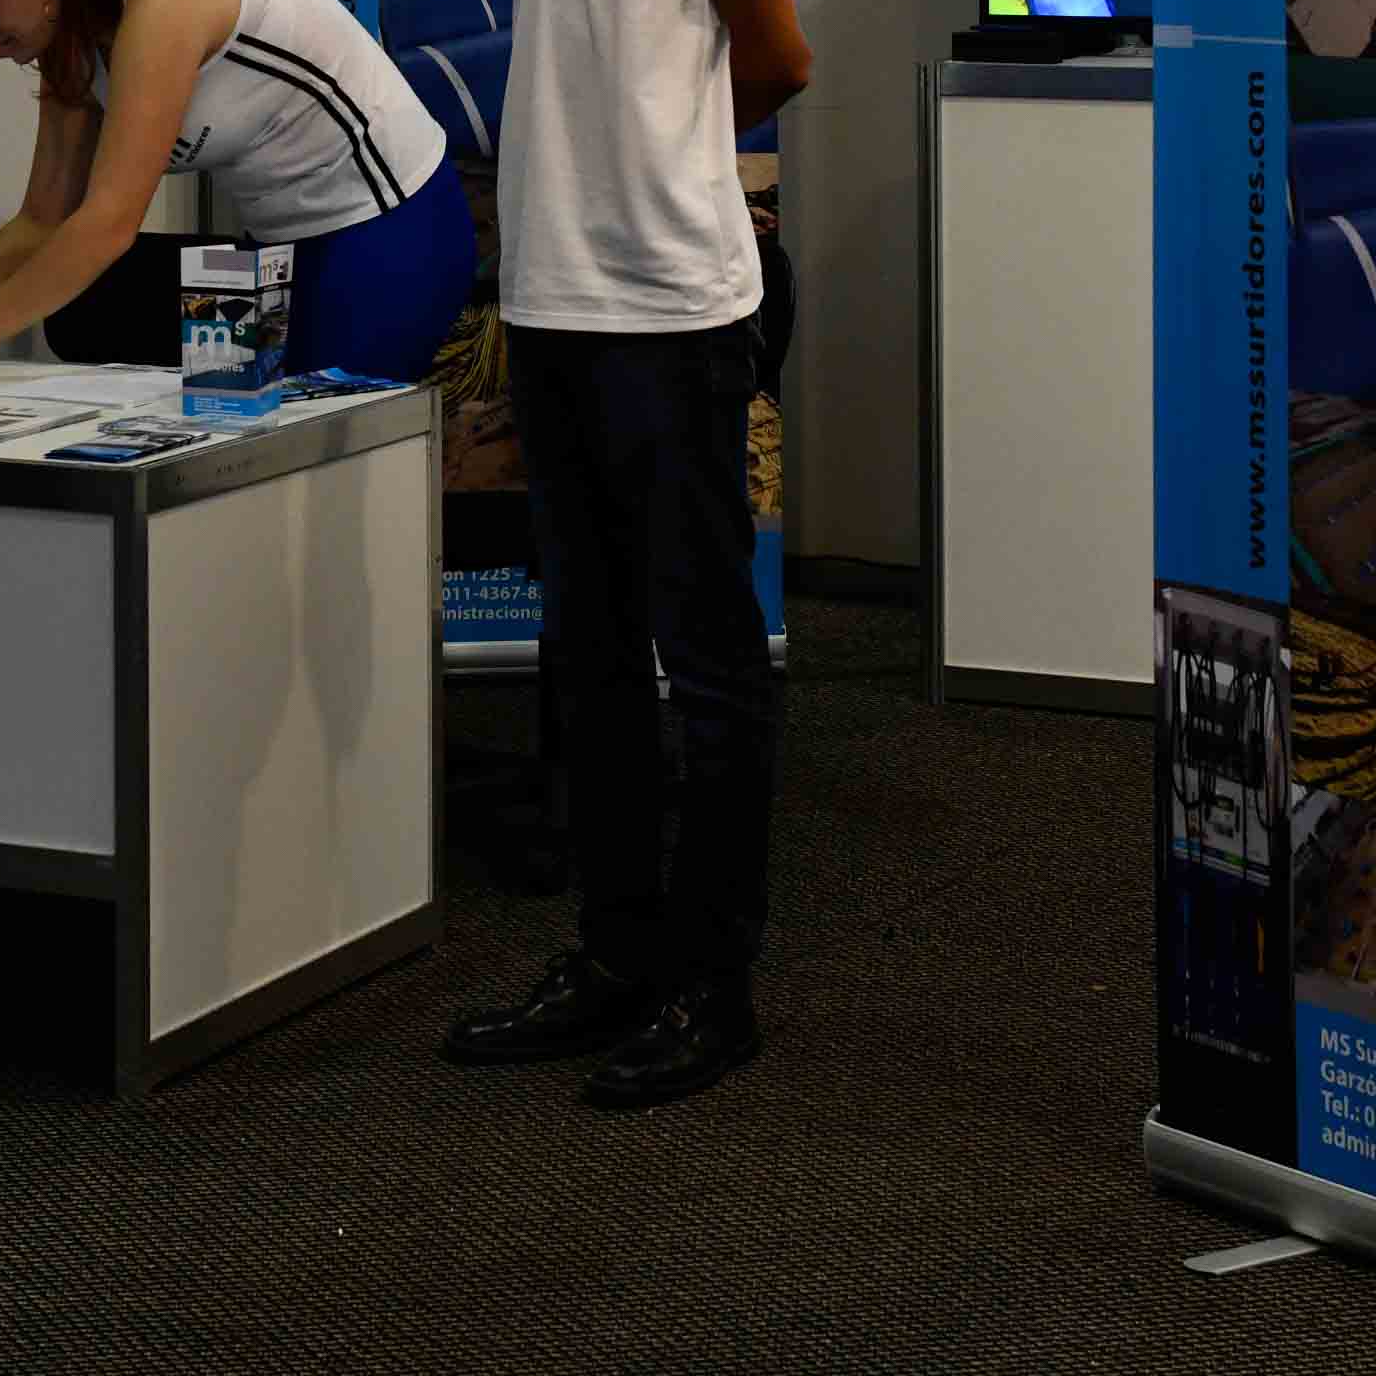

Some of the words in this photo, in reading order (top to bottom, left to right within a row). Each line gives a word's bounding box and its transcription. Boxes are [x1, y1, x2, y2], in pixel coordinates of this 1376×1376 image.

[1243, 71, 1264, 569] www.mssurtidores.com
[1320, 1027, 1351, 1056] MS
[1321, 1090, 1361, 1122] Tel.:
